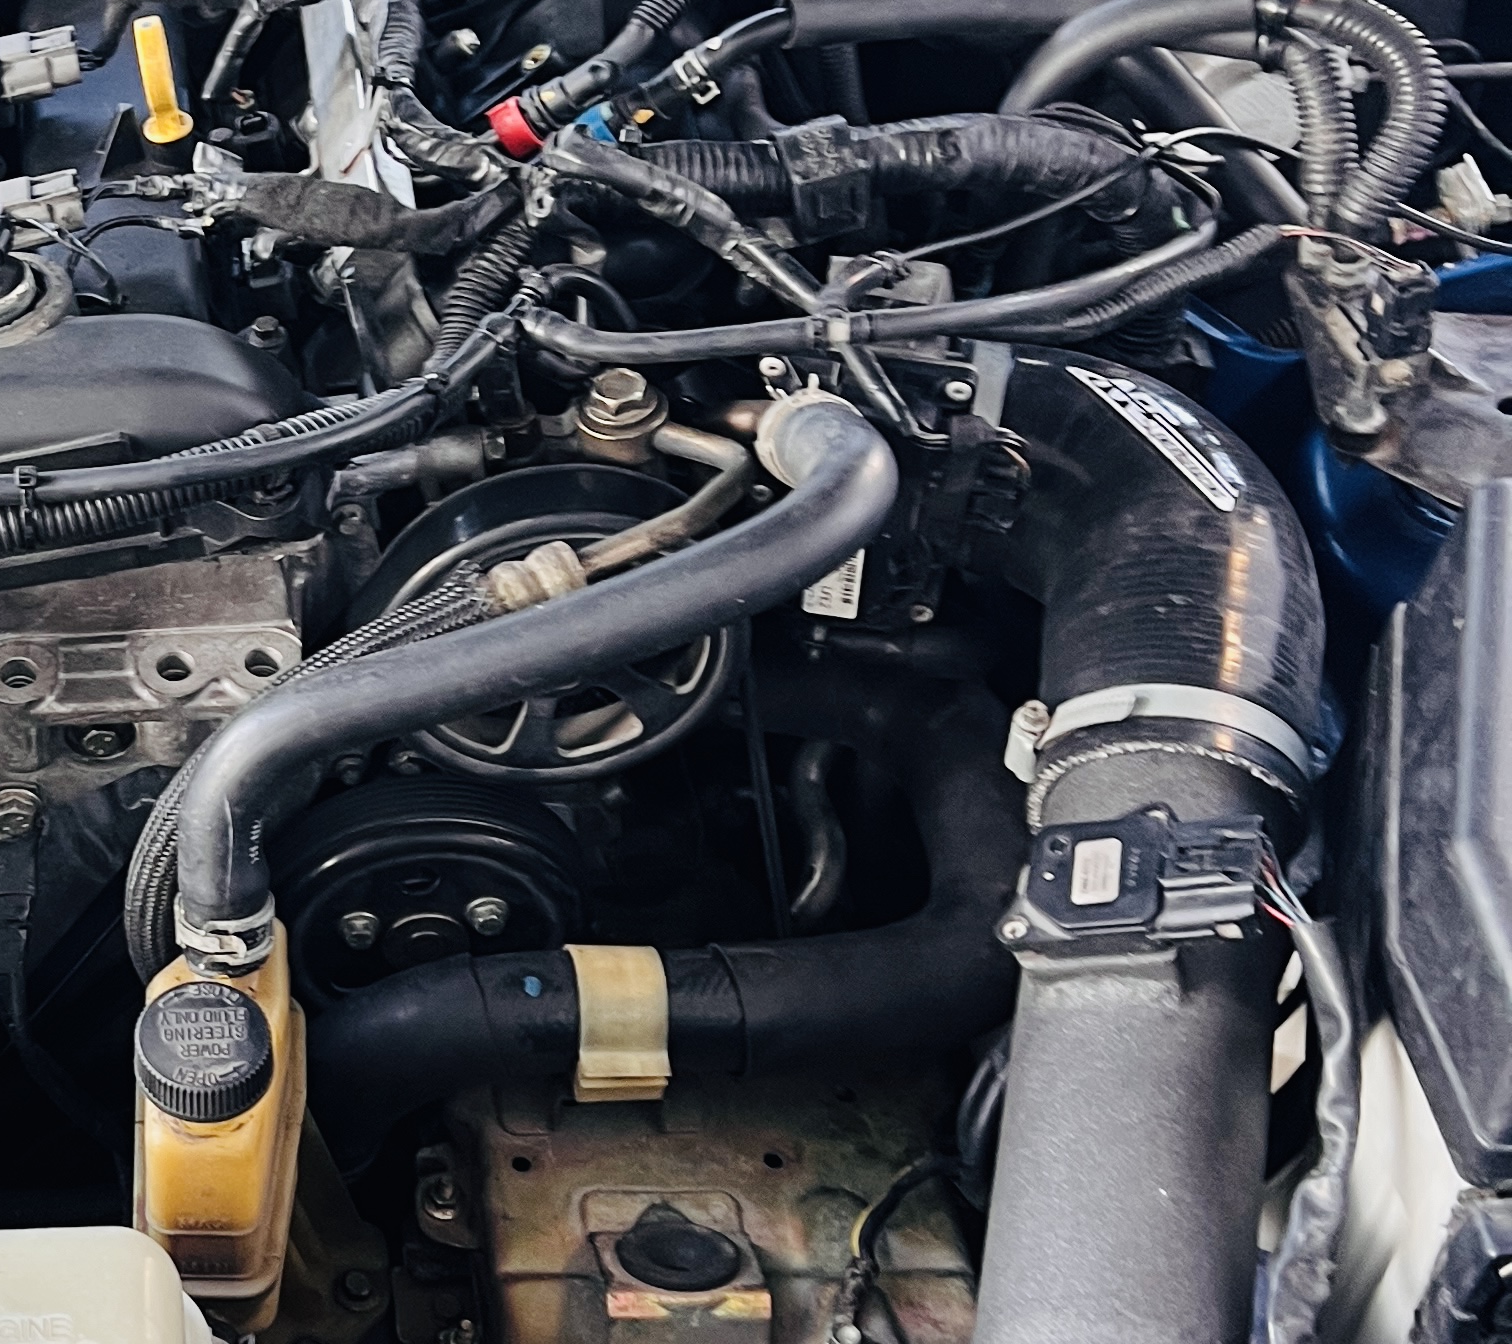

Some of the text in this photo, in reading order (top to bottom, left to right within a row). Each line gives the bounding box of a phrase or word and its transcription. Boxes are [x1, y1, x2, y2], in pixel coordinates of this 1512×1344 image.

[159, 1008, 248, 1025] FLUID ONLY
[162, 1025, 246, 1041] STEERING
[179, 1042, 232, 1058] POWER
[174, 1067, 219, 1087] OPEN
